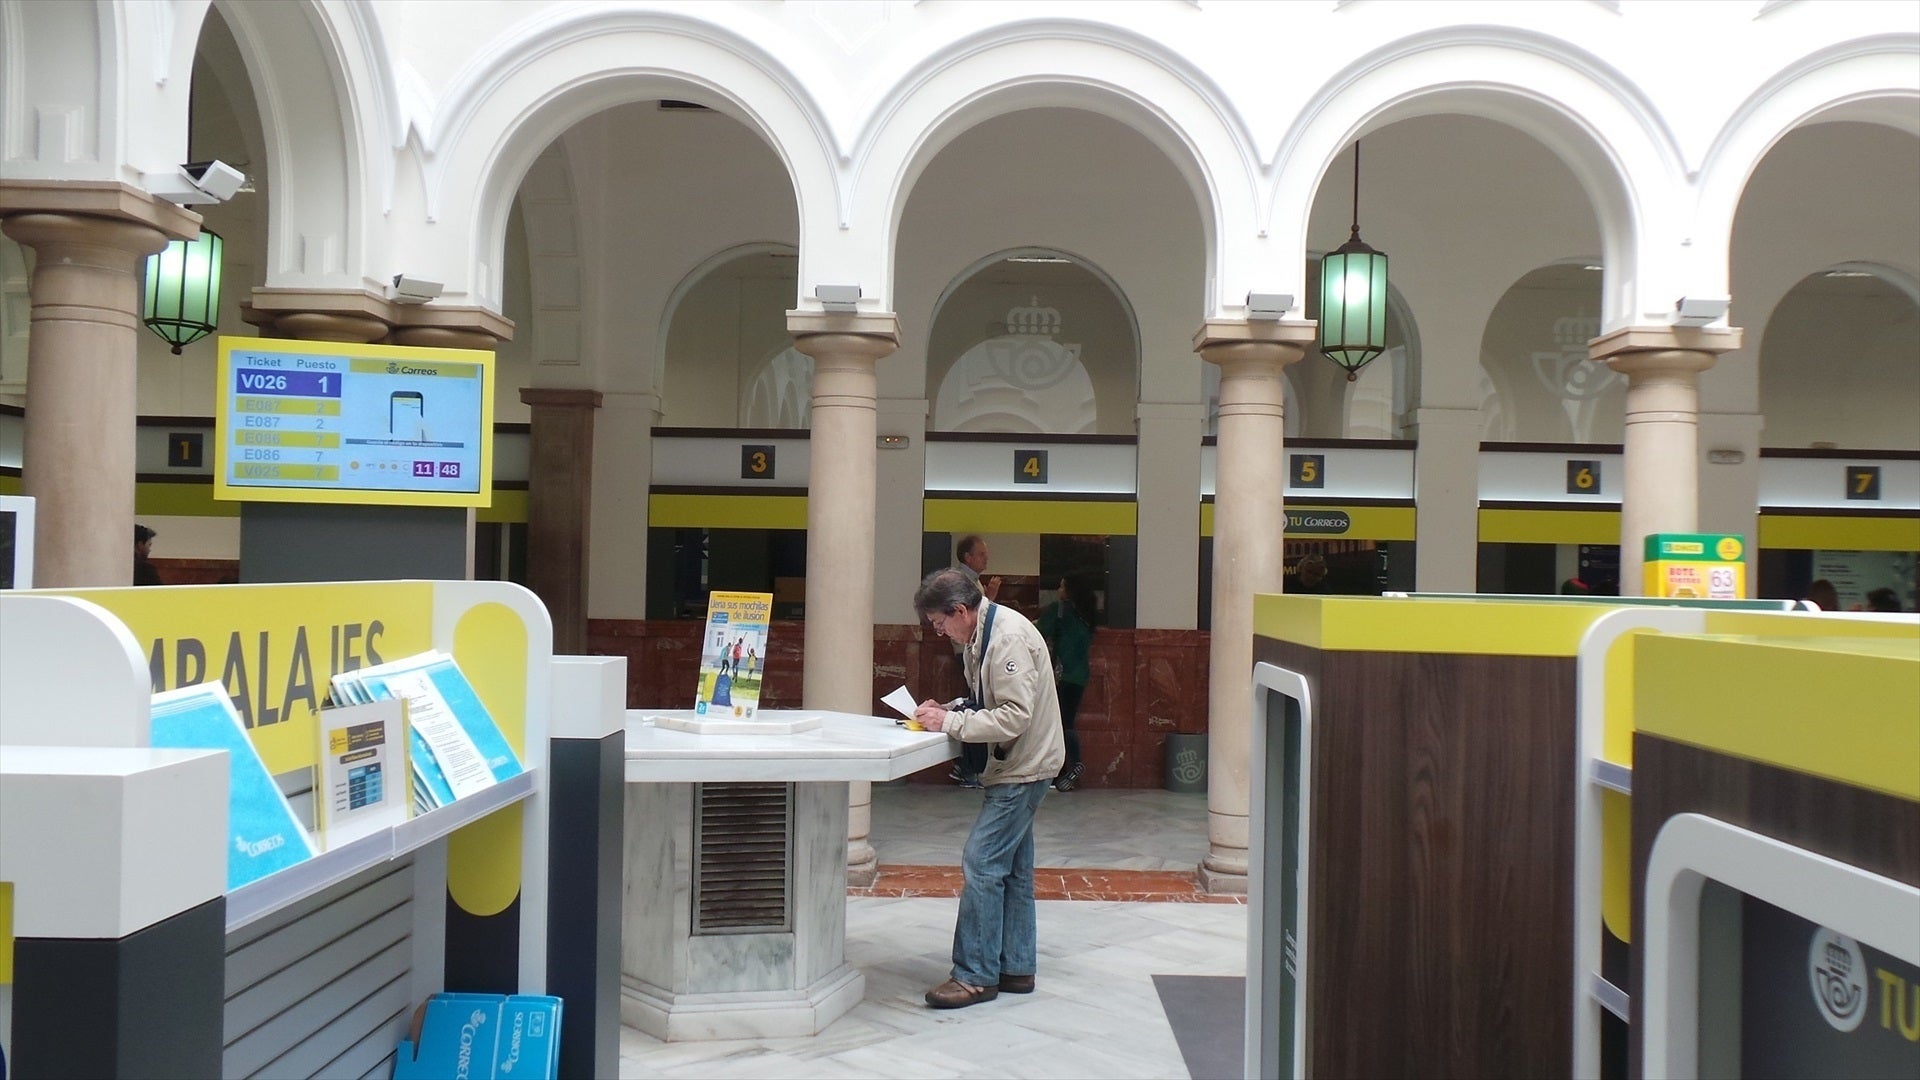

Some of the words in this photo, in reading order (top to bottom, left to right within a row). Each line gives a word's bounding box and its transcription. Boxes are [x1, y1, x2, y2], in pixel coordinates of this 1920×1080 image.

[246, 356, 282, 367] Ticket
[296, 358, 336, 370] Puesto
[401, 365, 438, 376] Correos
[240, 373, 287, 390] V026
[318, 376, 328, 393] 1
[244, 416, 280, 428] E087
[316, 419, 324, 430] 2
[180, 441, 190, 460] 1
[244, 449, 280, 461] E086
[315, 451, 323, 462] 7
[415, 462, 432, 475] 11
[441, 464, 458, 476] 48
[751, 452, 767, 473] 3
[1024, 457, 1040, 477] 4
[1301, 462, 1316, 482] 5
[1575, 469, 1593, 489] 6
[1855, 473, 1872, 493] 7
[1289, 516, 1302, 527] TU
[1711, 571, 1733, 588] 63
[727, 602, 737, 610] sus
[740, 602, 769, 611] mochilas
[733, 611, 742, 620] de
[1875, 966, 1920, 1042] TU
